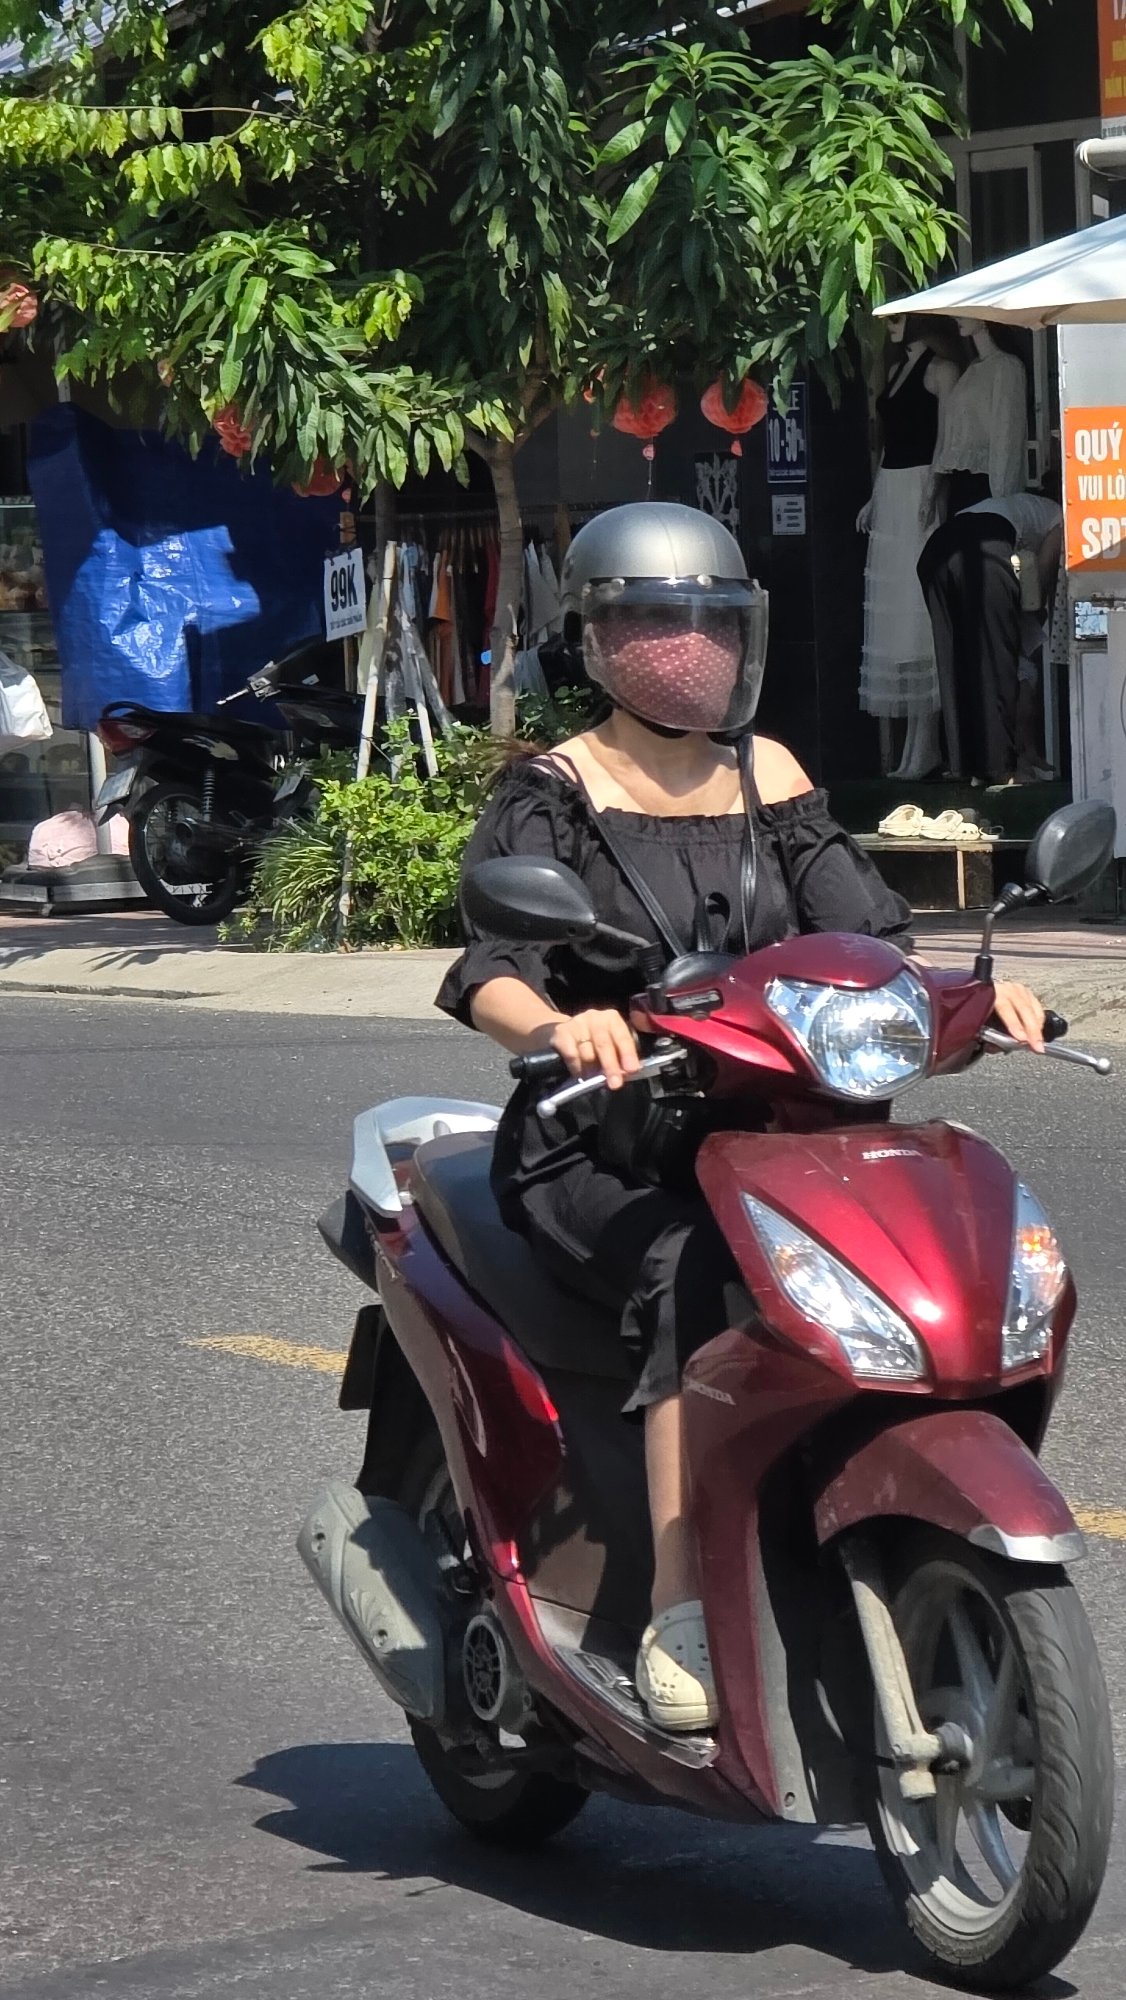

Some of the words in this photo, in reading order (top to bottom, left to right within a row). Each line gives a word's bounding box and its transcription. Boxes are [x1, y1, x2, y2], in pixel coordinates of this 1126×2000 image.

[1075, 421, 1123, 465] QUÝ
[1078, 475, 1103, 501] VUI
[330, 563, 358, 612] 99K
[862, 1149, 922, 1160] HONDA
